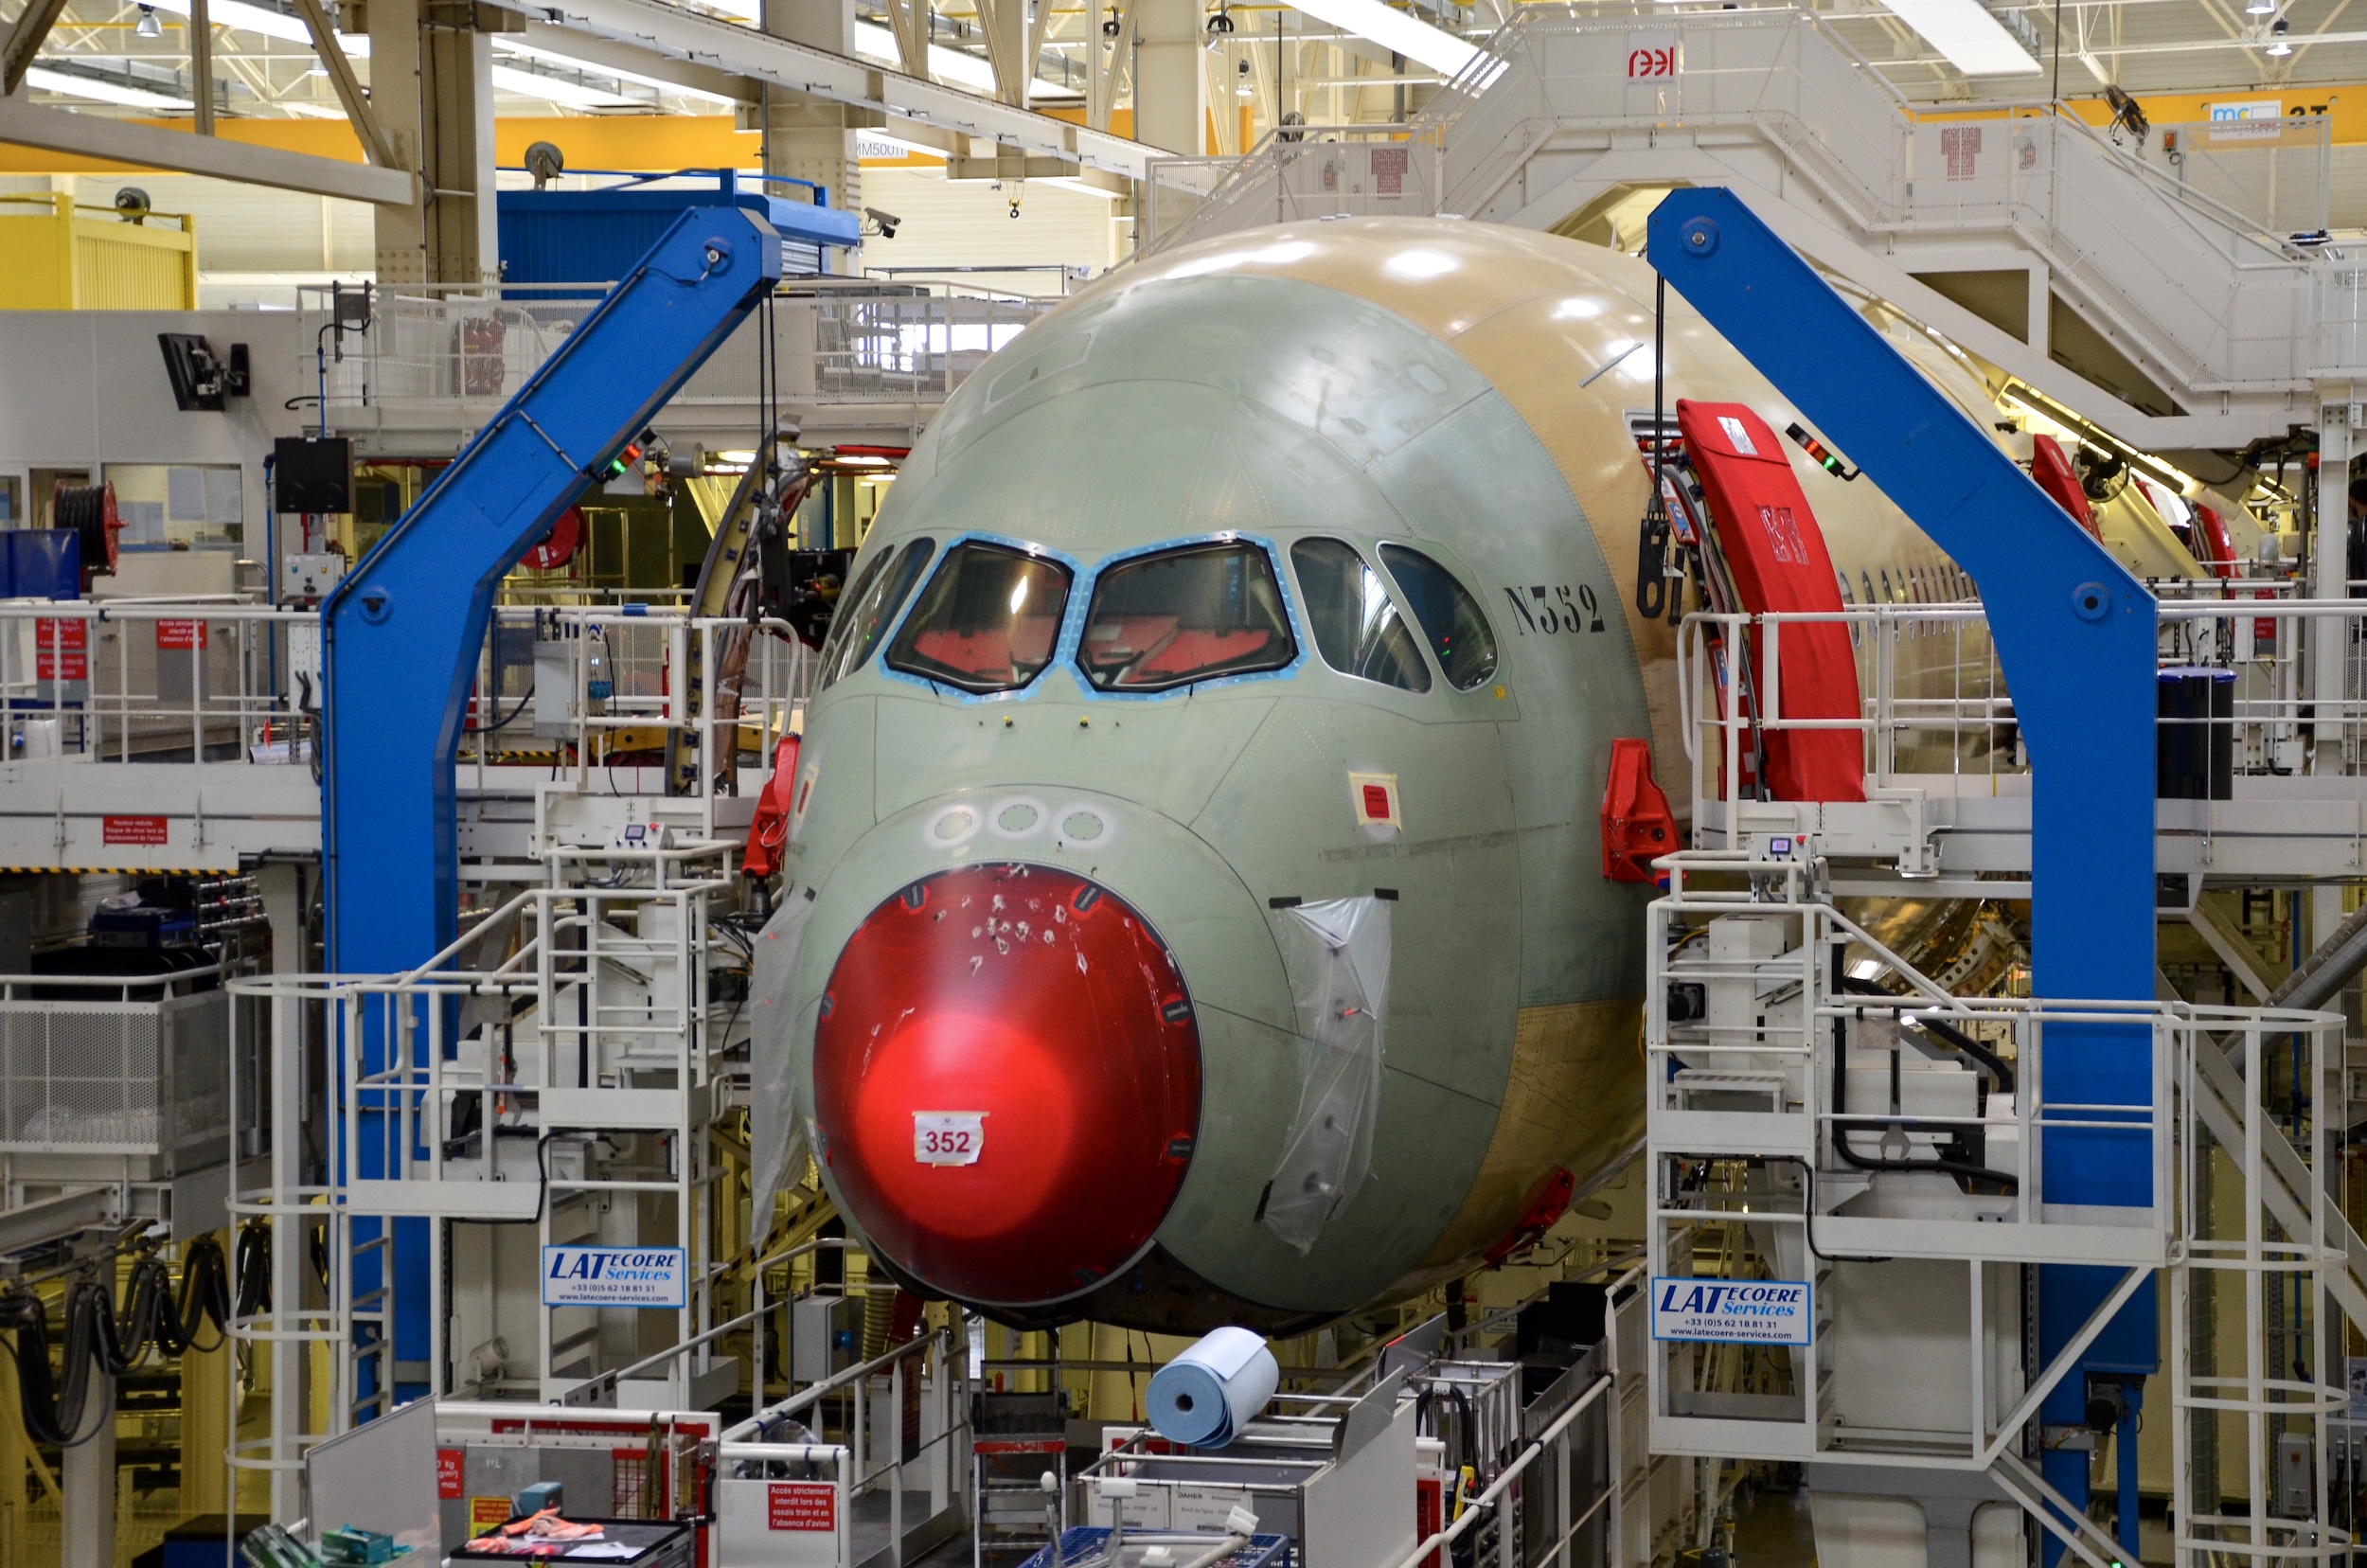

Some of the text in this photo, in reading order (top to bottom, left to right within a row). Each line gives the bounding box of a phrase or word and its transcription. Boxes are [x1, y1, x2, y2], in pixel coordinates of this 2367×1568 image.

[925, 1131, 970, 1153] 352
[549, 1253, 678, 1279] LATECOERE
[605, 1267, 672, 1281] Services
[589, 1284, 605, 1292] (0)5
[559, 1293, 668, 1302] www.latecoere-services.com
[1659, 1284, 1802, 1314] LATECOERE
[1721, 1301, 1795, 1317] Services
[1684, 1318, 1701, 1326] +33
[1704, 1319, 1722, 1327] (0)5
[1670, 1327, 1792, 1339] www.latecoere-services.com
[771, 1486, 792, 1494] Accès
[772, 1519, 830, 1527] l'absence d'avion
